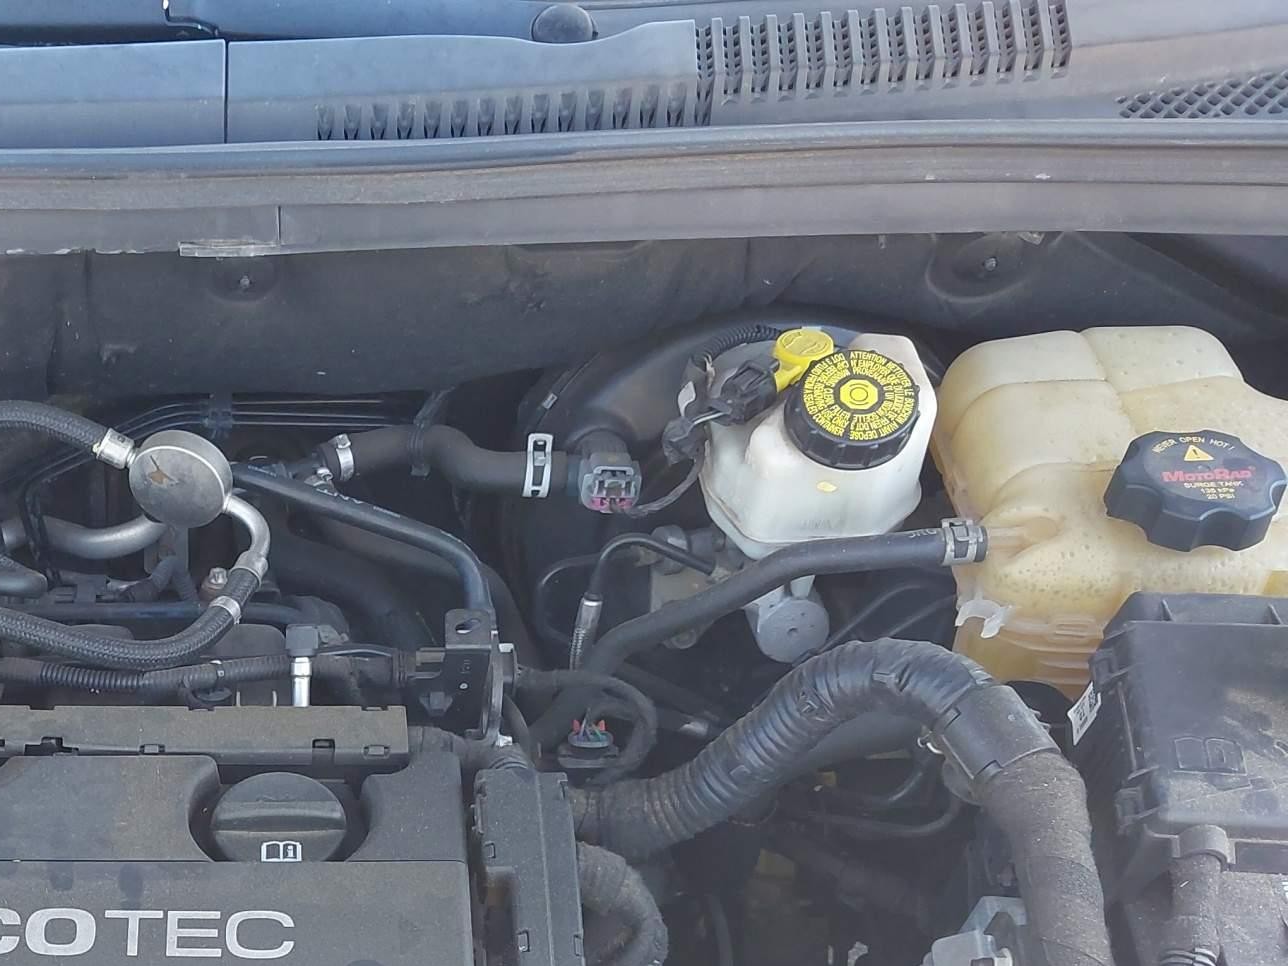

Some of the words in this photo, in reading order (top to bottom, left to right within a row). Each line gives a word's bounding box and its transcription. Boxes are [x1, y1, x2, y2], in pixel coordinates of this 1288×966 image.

[830, 352, 845, 363] DOT
[849, 351, 888, 364] ATTENTION
[834, 359, 849, 370] CAP
[885, 359, 912, 387] NETTOYER
[886, 372, 901, 385] QUE
[904, 388, 914, 396] LE
[894, 398, 914, 424] BOUCHON
[876, 420, 900, 437] AVANT
[1179, 436, 1206, 444] OPEN
